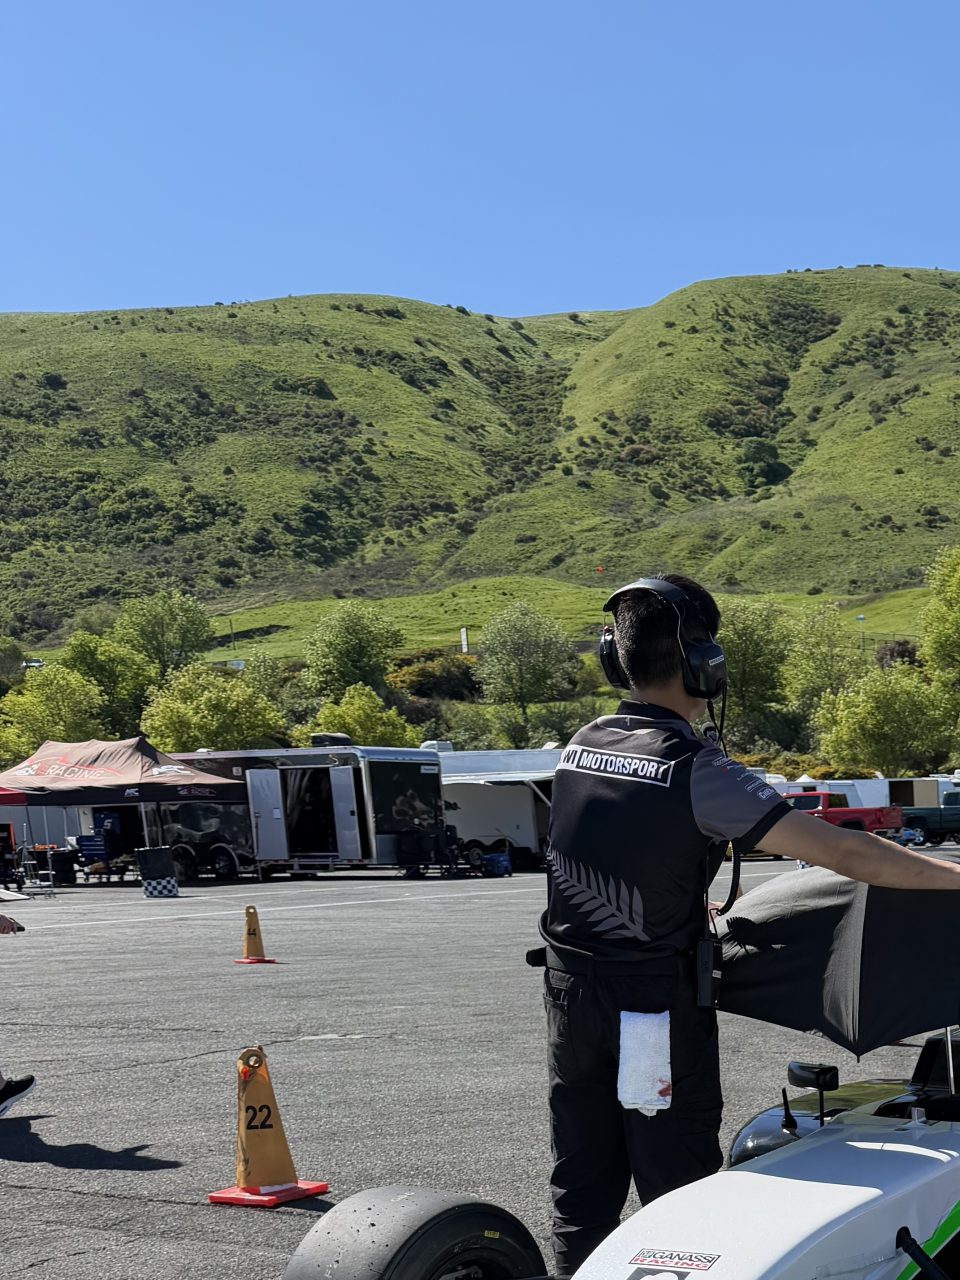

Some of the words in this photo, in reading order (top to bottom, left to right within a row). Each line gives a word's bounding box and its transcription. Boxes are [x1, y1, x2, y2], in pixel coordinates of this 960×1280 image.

[580, 752, 667, 779] MOTORSPORT
[245, 1104, 273, 1130] 22
[633, 1257, 709, 1269] RACING
[652, 1251, 715, 1264] GANASSI
